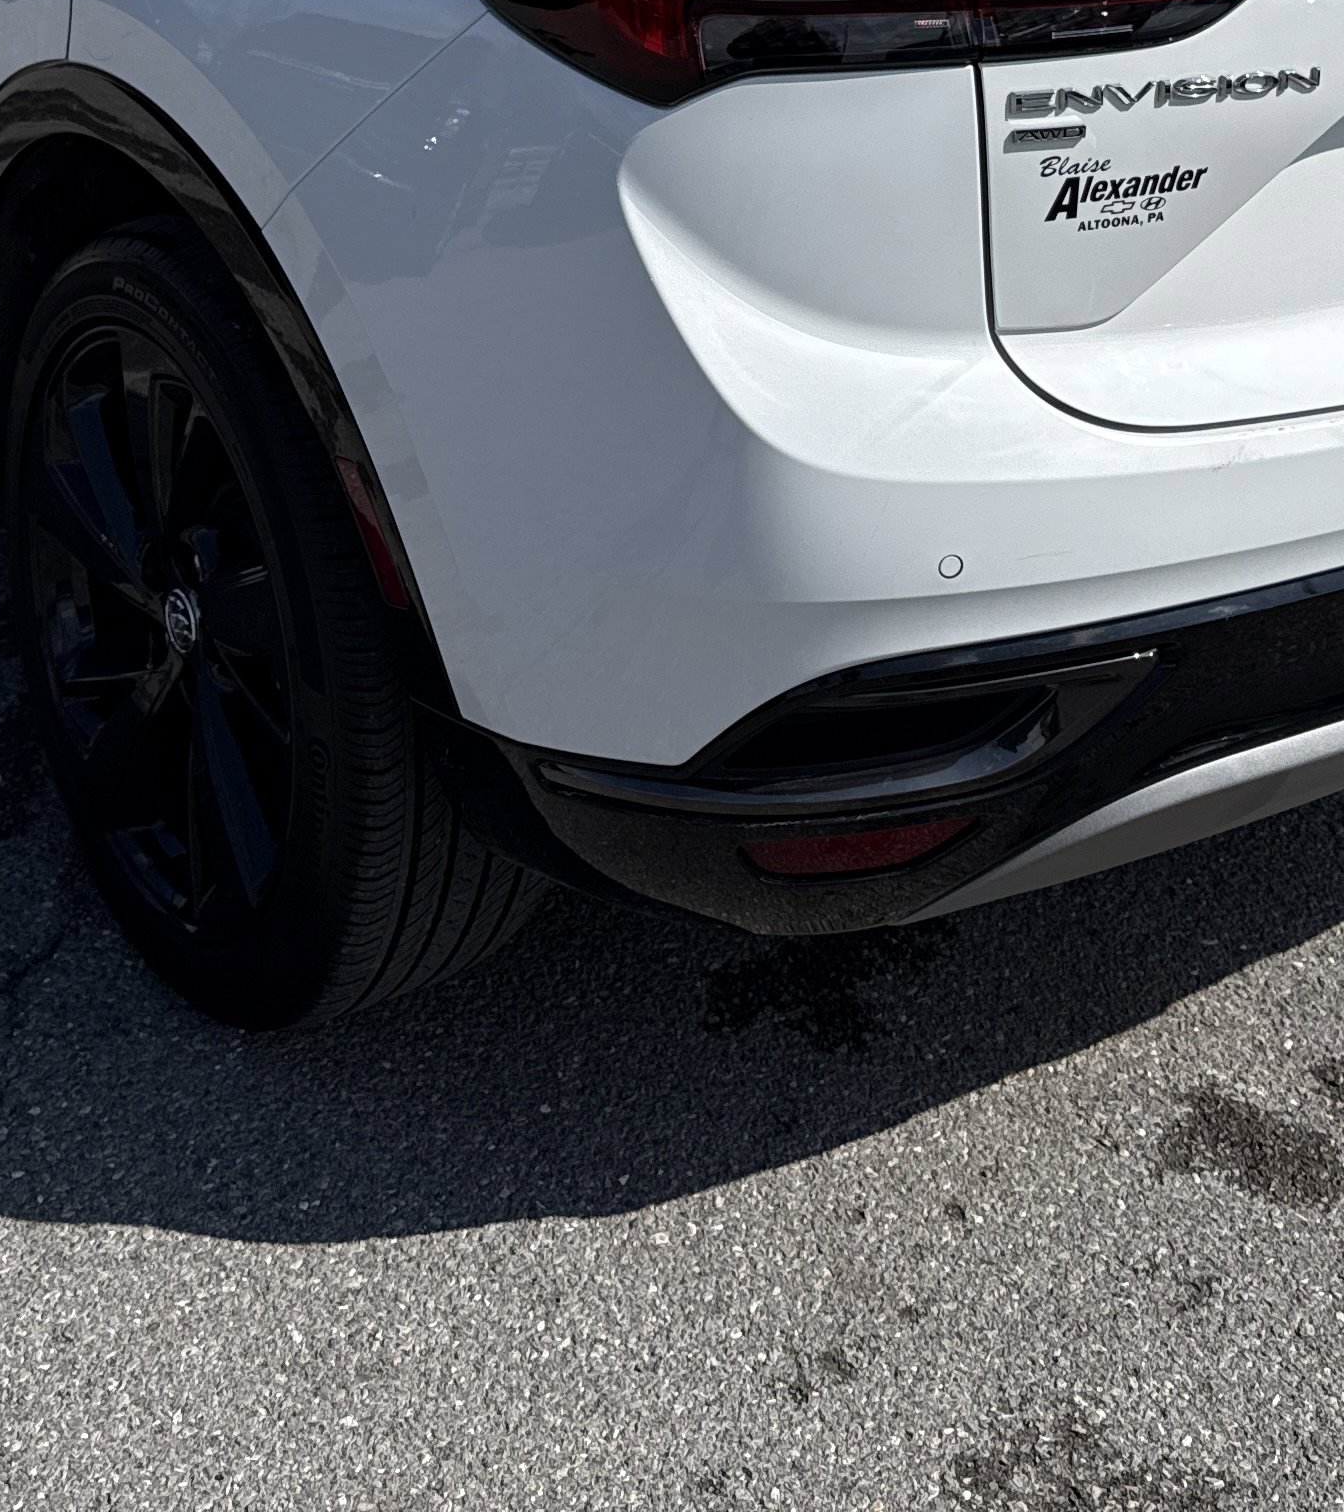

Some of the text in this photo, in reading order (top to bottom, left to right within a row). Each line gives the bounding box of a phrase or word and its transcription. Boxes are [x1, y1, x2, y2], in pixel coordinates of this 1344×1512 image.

[1007, 66, 1321, 116] ENVISION
[1017, 127, 1085, 142] AWD
[1039, 155, 1112, 178] Blaise
[1043, 165, 1209, 223] Alexander
[1077, 211, 1164, 233] ALTOONA, PA
